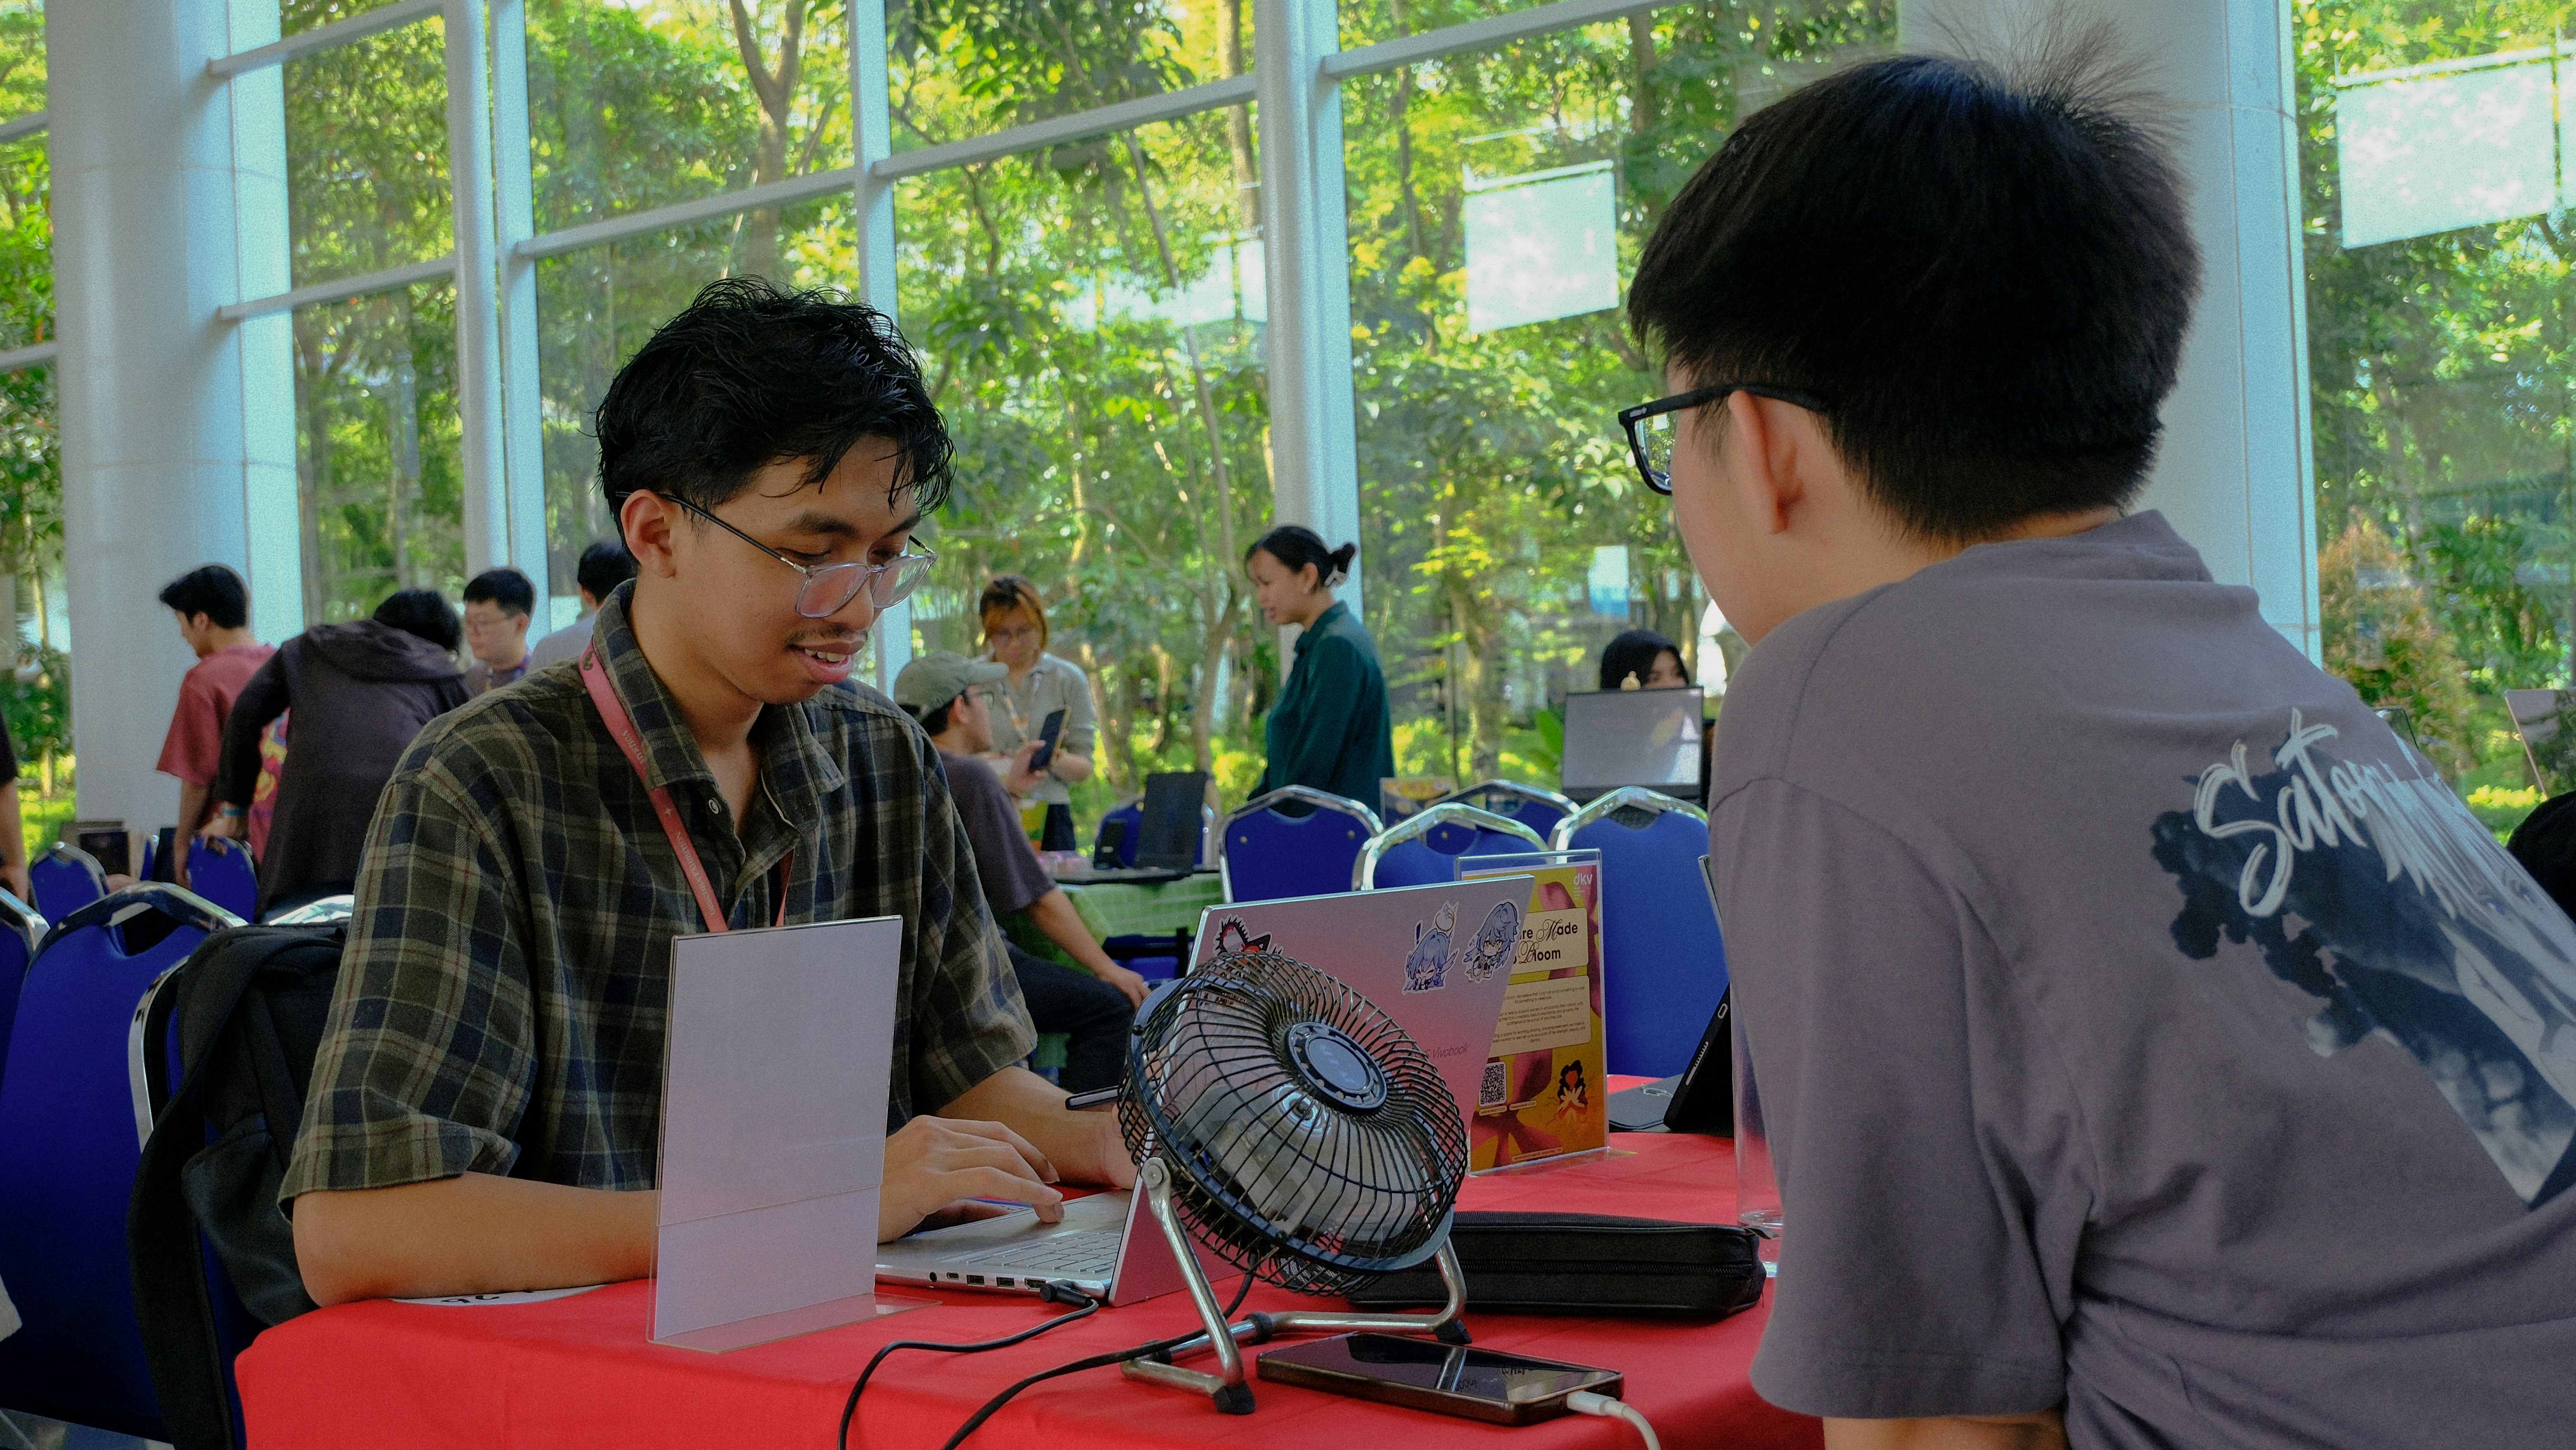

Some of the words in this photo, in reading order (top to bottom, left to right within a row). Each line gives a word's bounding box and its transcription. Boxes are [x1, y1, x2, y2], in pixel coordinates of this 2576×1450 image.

[676, 831, 699, 877] EXHIBITION
[1574, 873, 1593, 885] dkv
[1536, 919, 1578, 942] Made
[1518, 941, 1561, 964] Bloom
[1433, 1042, 1468, 1059] Vivobook
